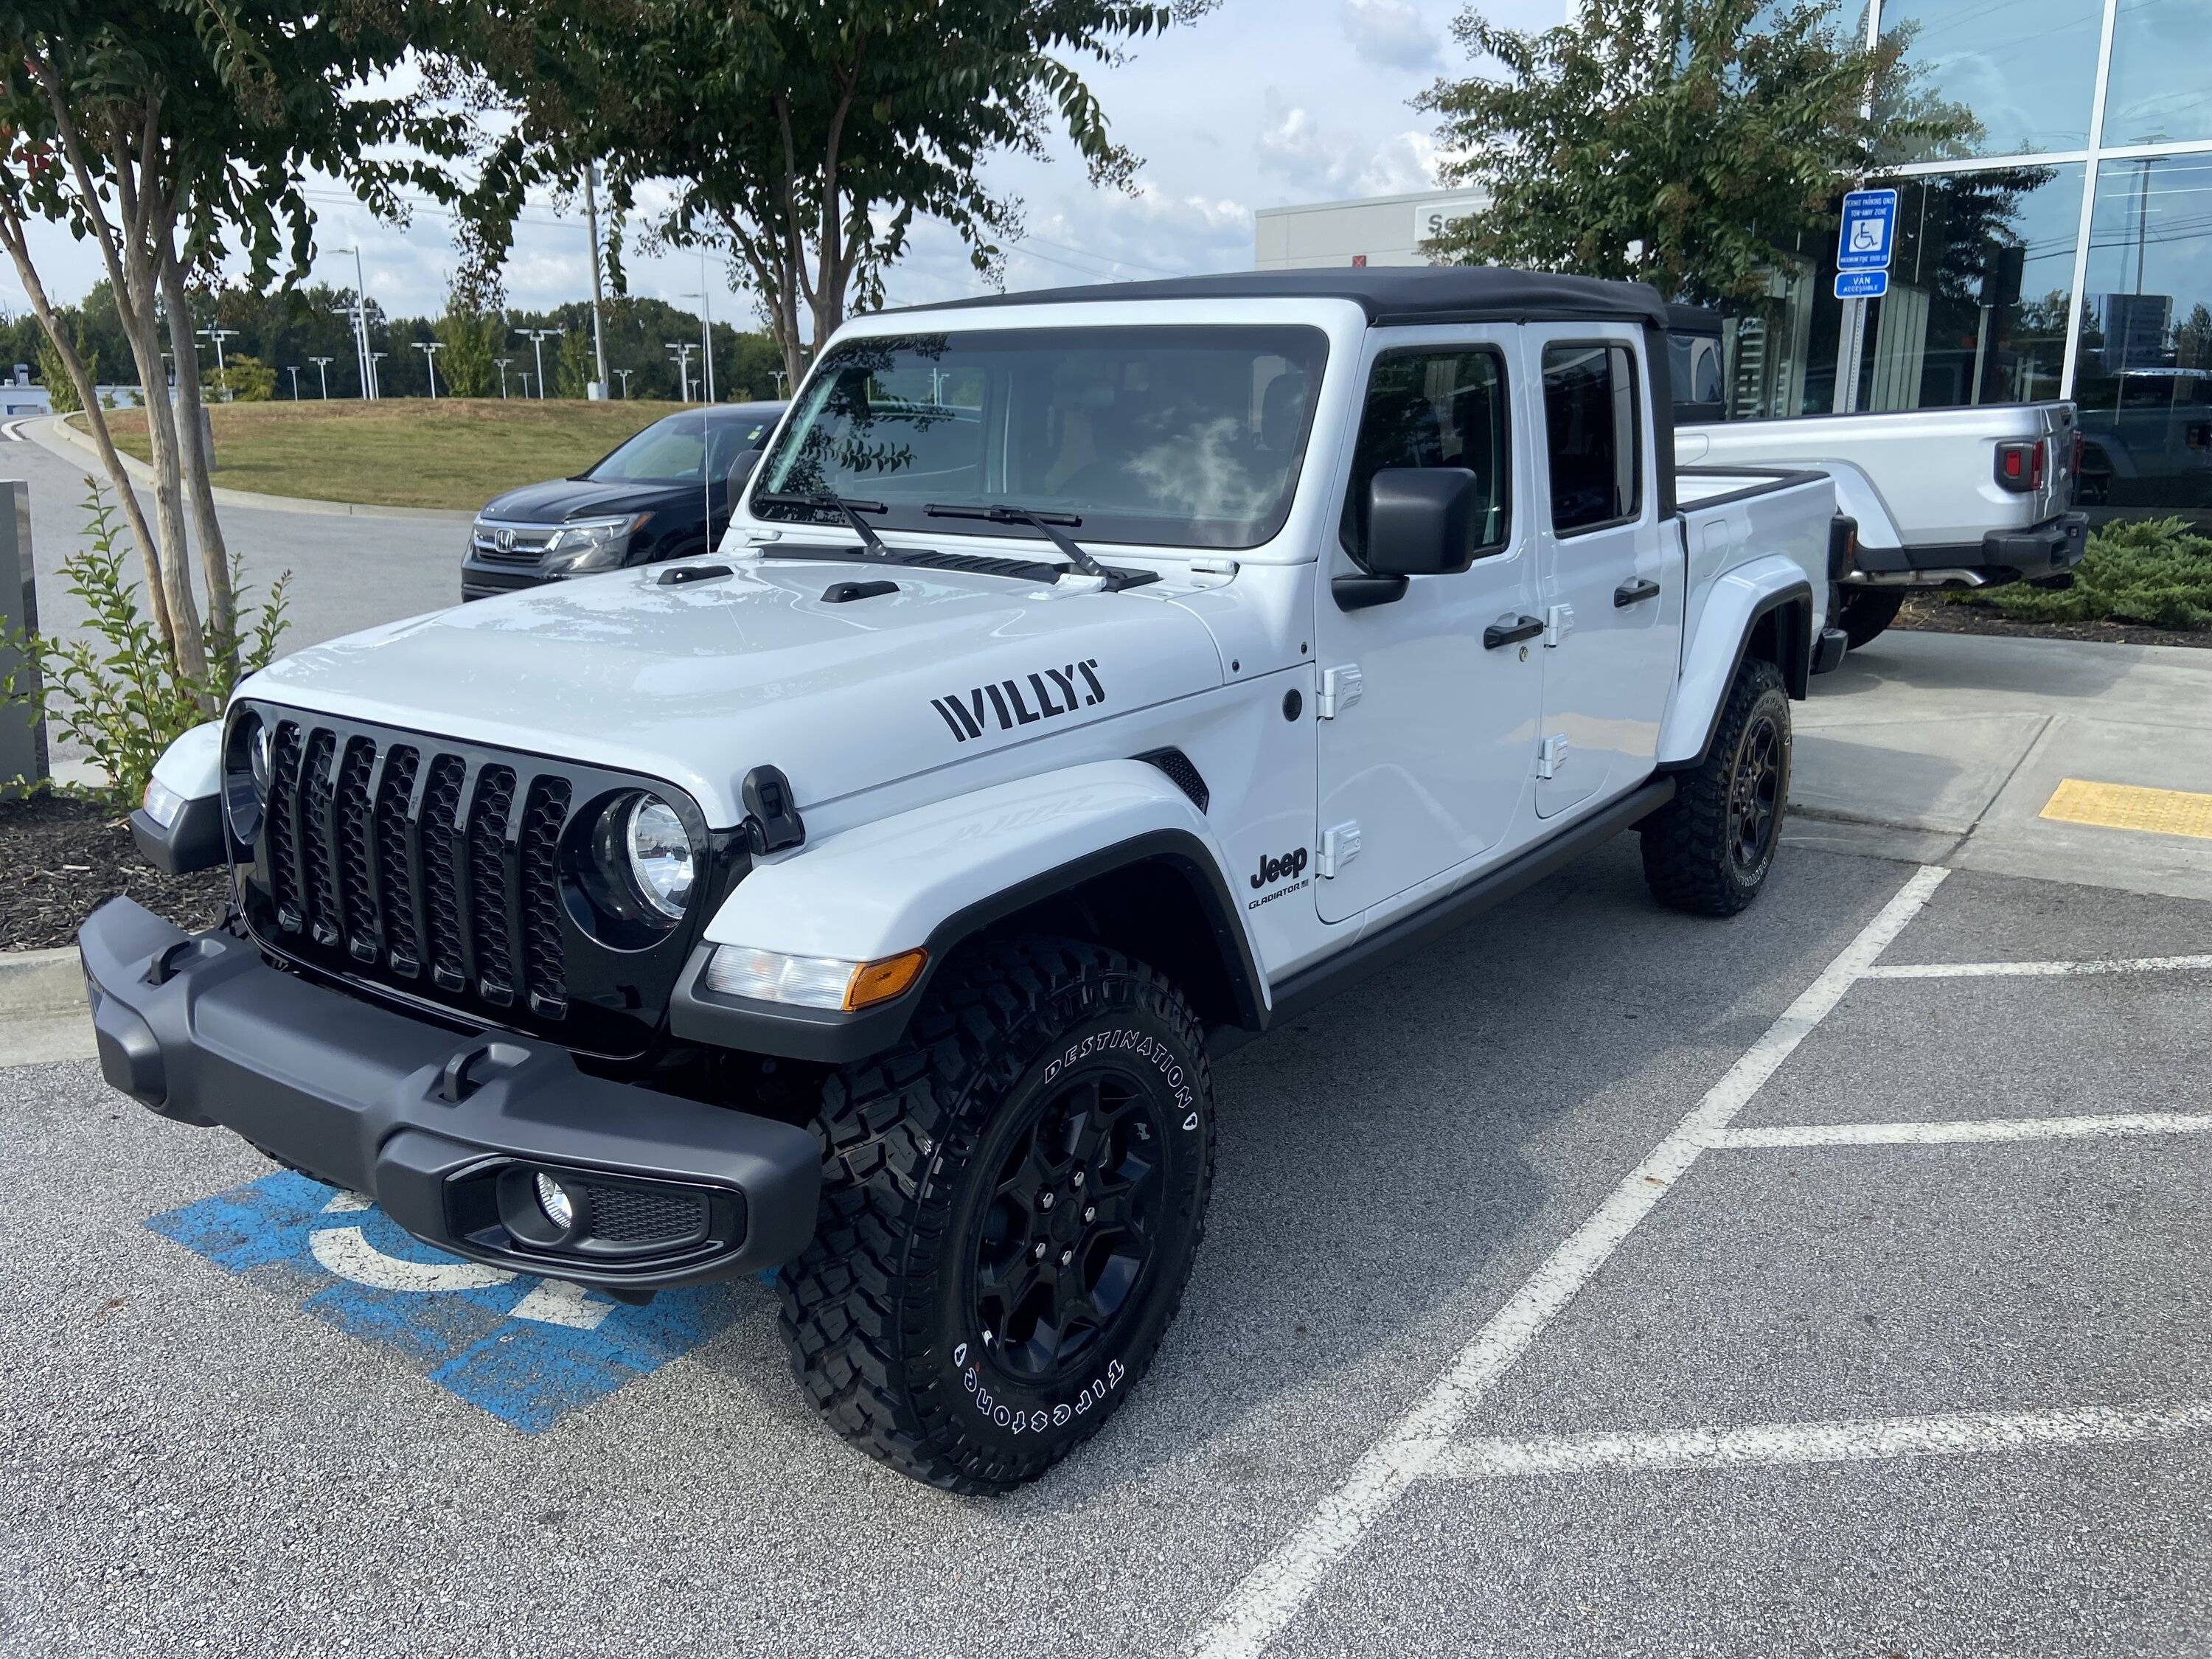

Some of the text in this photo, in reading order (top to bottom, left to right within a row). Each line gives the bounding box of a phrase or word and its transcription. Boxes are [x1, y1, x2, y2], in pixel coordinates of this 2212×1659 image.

[1844, 197, 1894, 207] PERMIT PARKING ONLY
[1874, 208, 1888, 216] ZONE
[1843, 285, 1879, 293] ACCESSIBLE
[1853, 276, 1871, 285] VAN
[930, 659, 1105, 742] WILLYS
[1251, 847, 1307, 888] Jeep
[1249, 883, 1300, 910] GLADIATOR
[1045, 1030, 1192, 1109] DESTINATION
[964, 1360, 1124, 1435] Firestone
